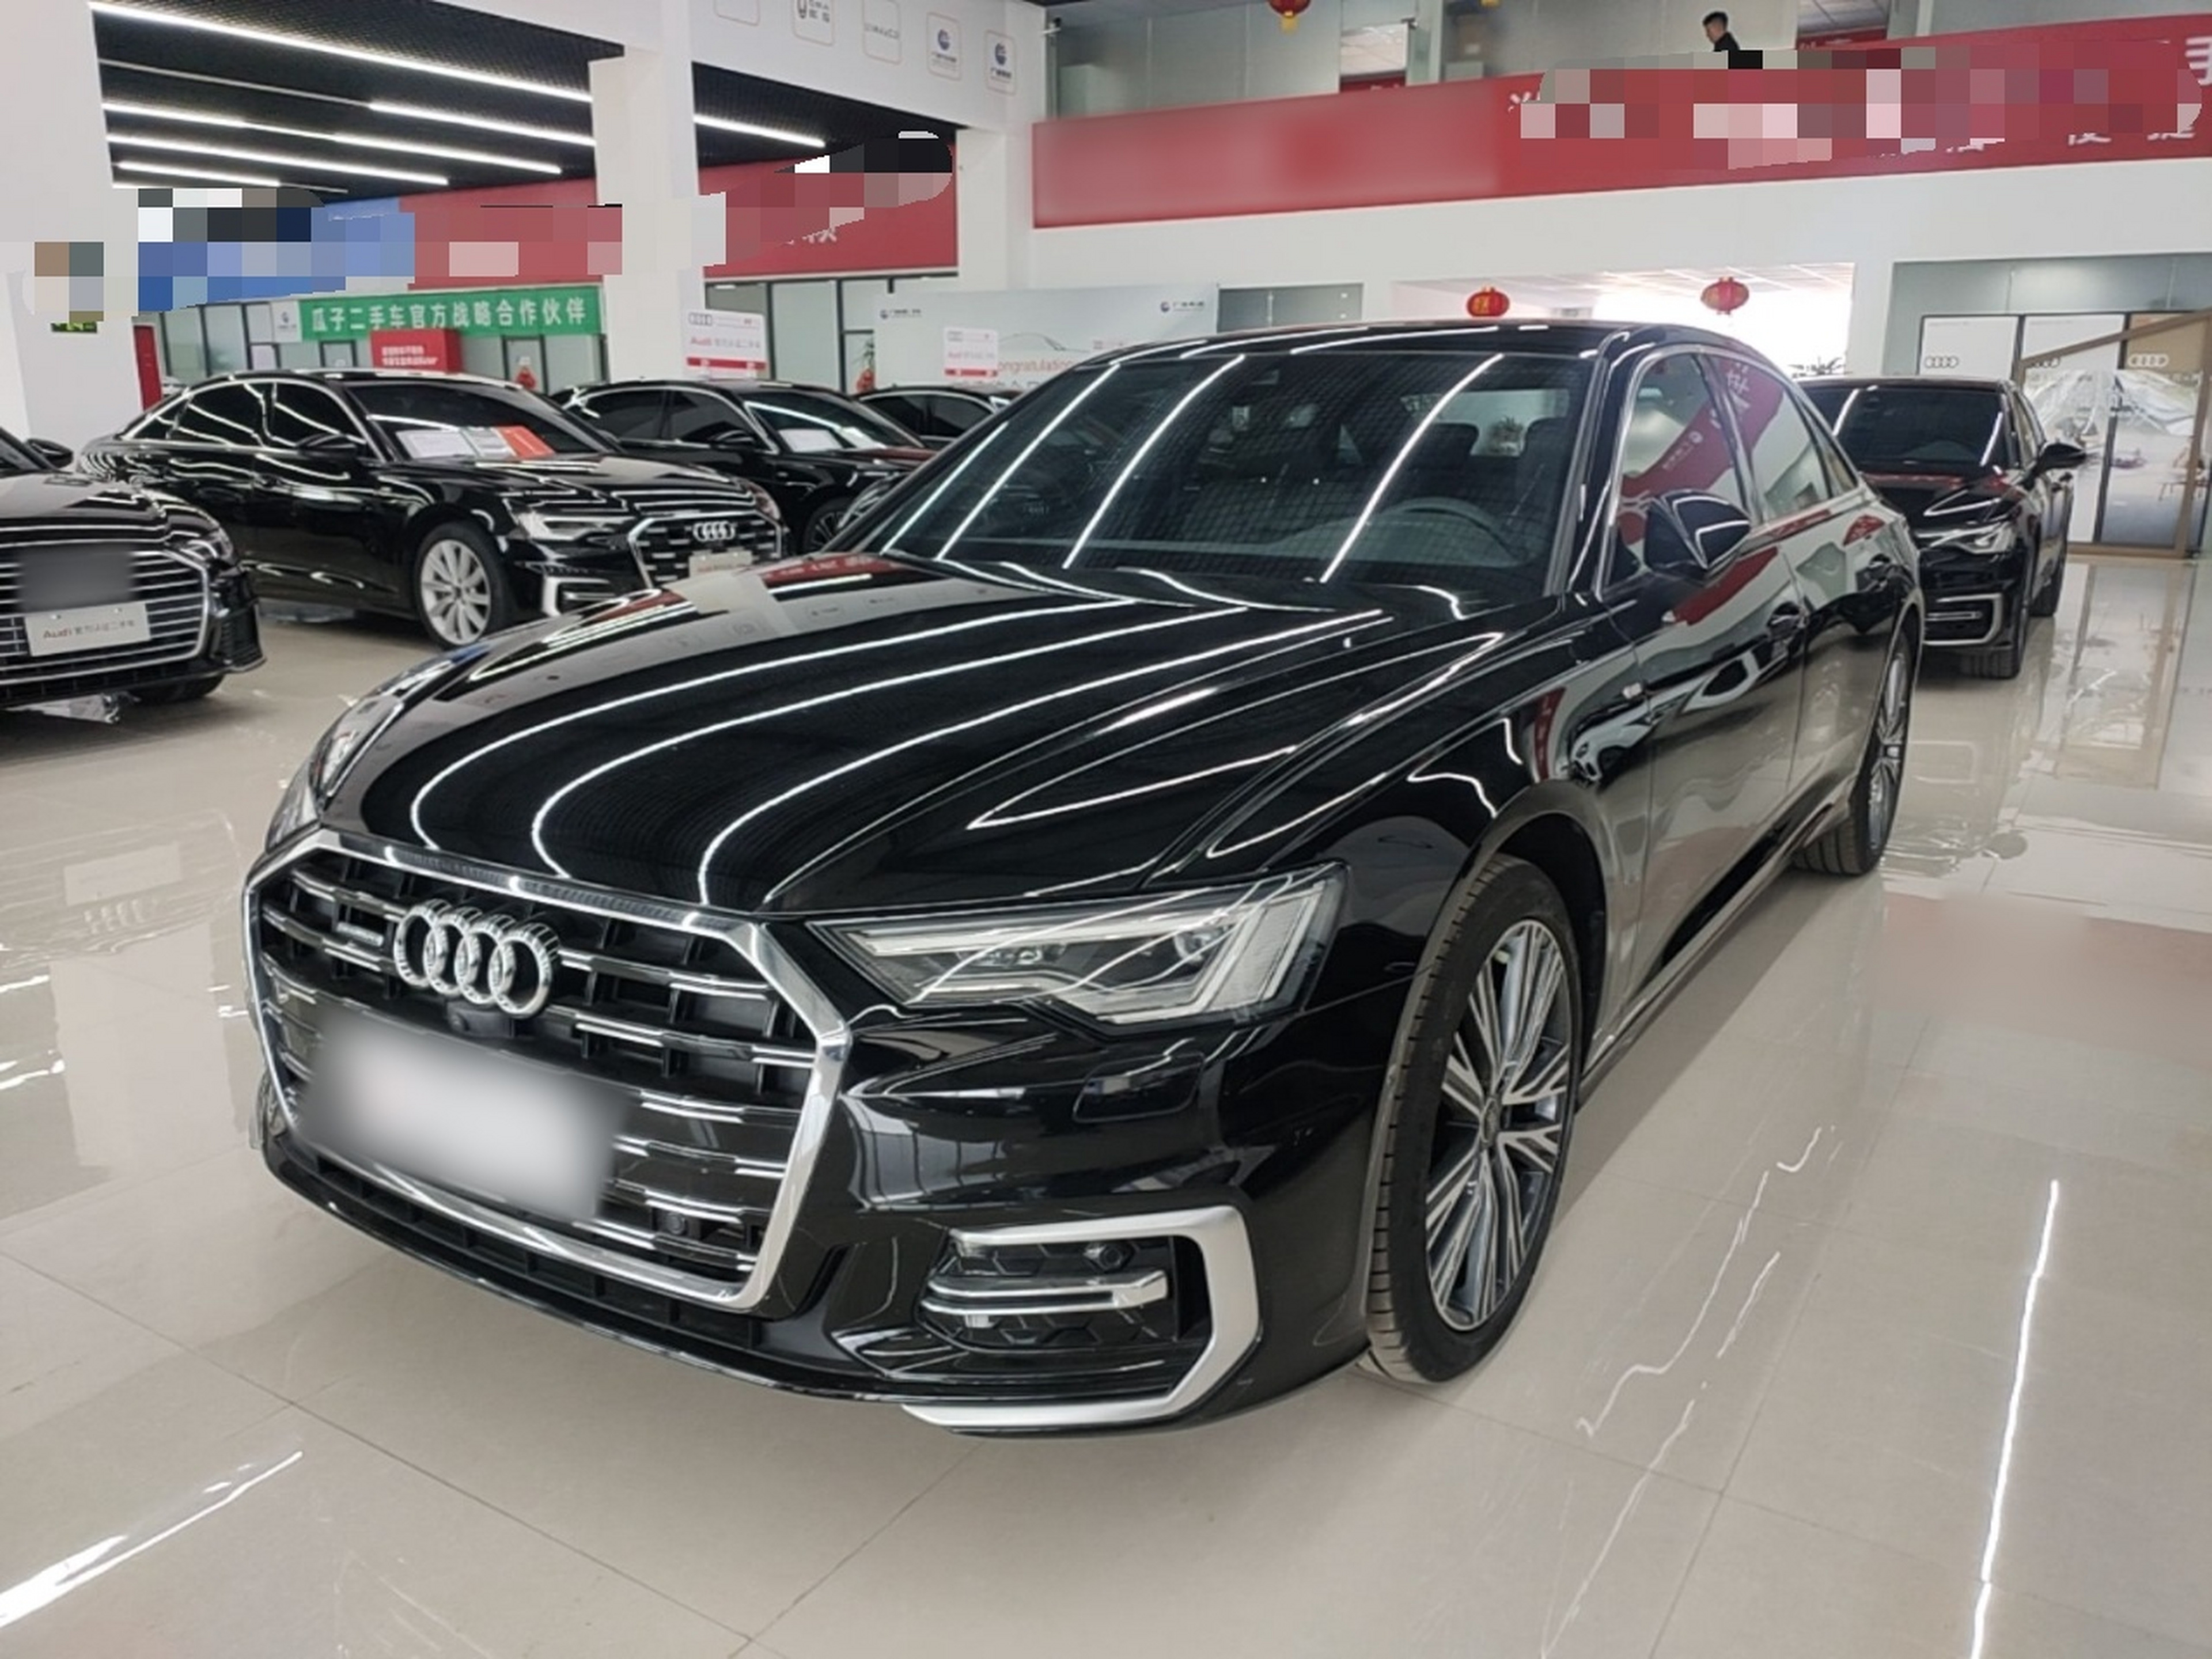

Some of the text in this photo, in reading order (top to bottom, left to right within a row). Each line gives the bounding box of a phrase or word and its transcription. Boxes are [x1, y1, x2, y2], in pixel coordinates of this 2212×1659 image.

[312, 297, 586, 332] 瓜子二手车官方战略合作伙伴
[43, 628, 73, 639] Audi
